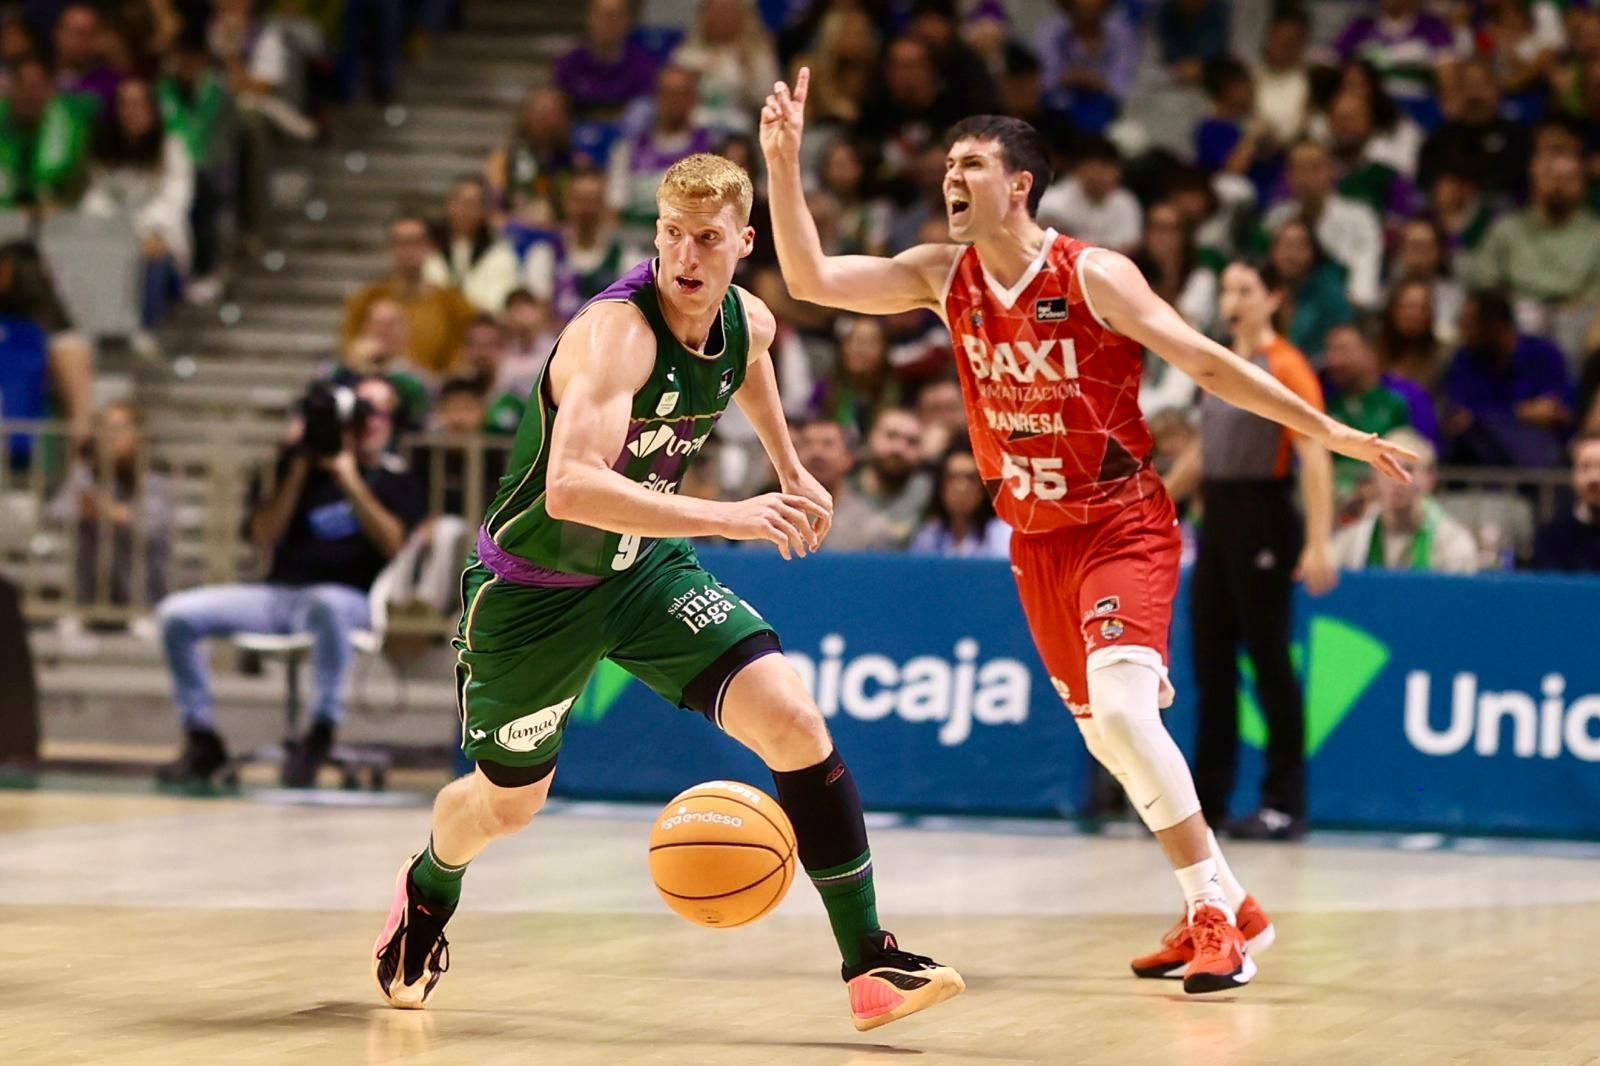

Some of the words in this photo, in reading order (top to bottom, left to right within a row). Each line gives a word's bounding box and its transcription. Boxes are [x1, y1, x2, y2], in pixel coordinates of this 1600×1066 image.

[961, 333, 1079, 383] BAXI
[1001, 451, 1068, 500] 55
[667, 586, 697, 615] sabor
[681, 600, 737, 635] laga
[784, 632, 1032, 747] nicaja
